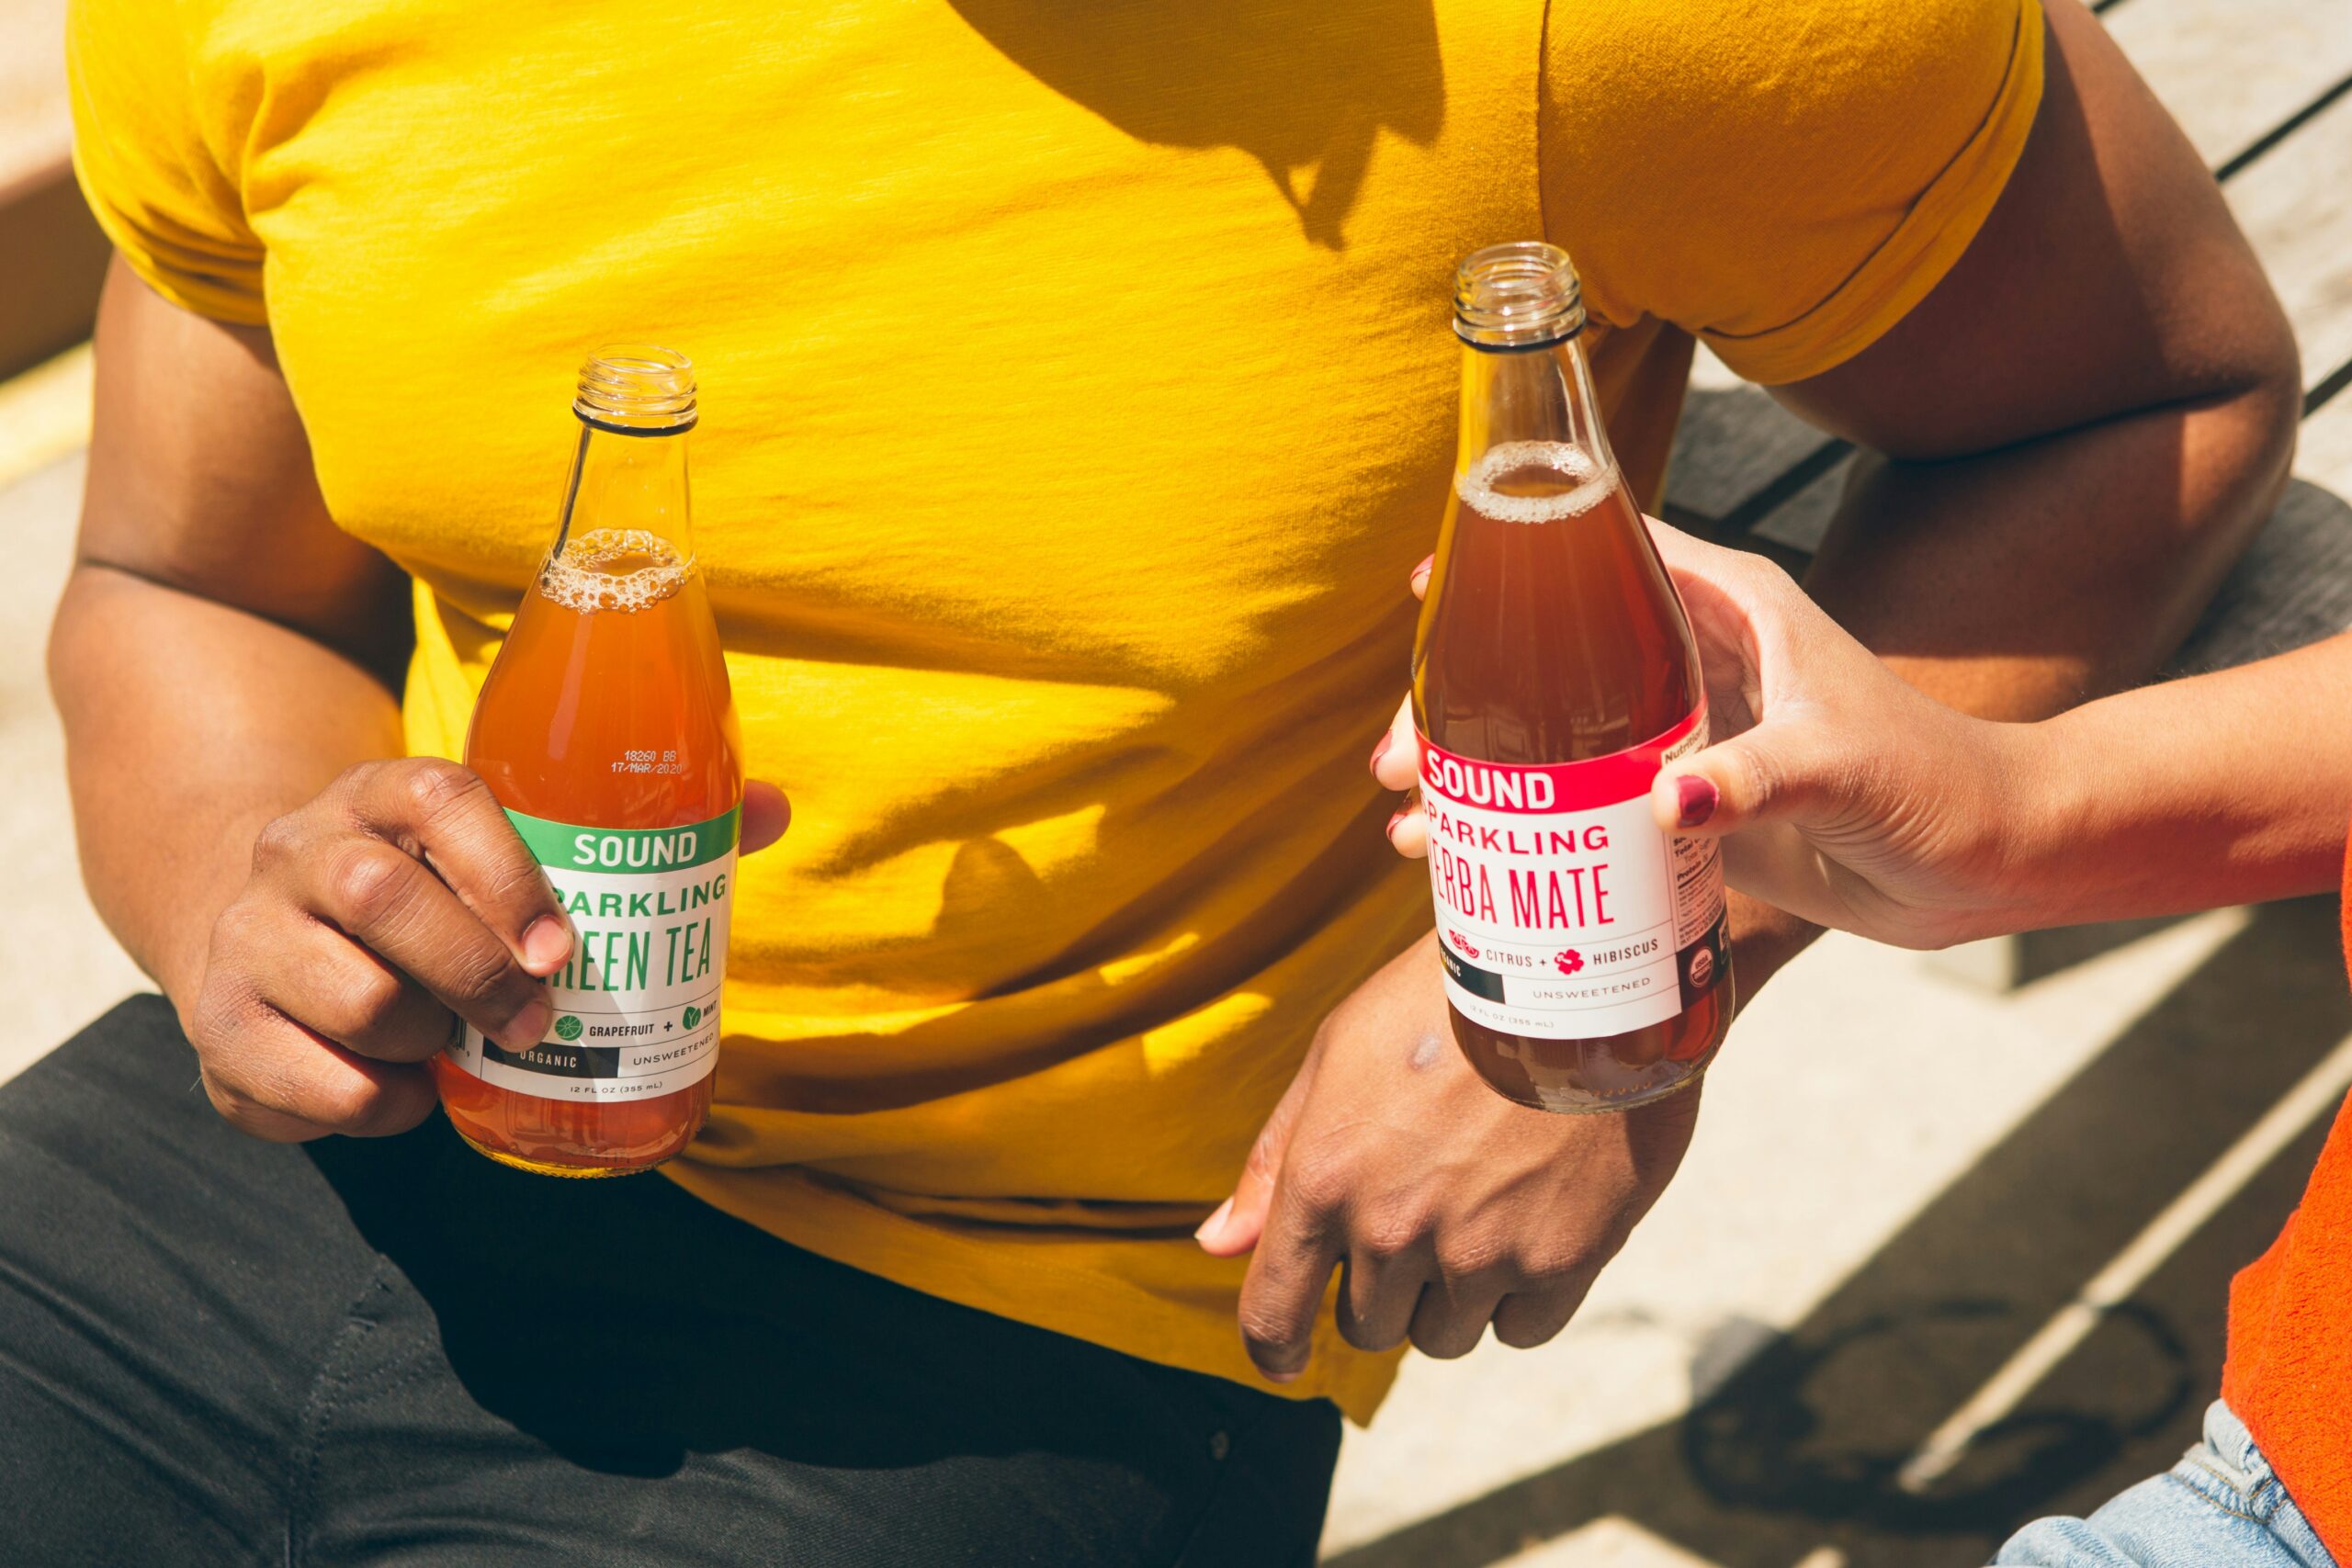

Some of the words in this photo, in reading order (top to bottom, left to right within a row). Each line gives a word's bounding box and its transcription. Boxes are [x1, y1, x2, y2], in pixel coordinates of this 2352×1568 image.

[611, 761, 683, 774] 17/MAR/2020
[624, 750, 656, 761] 18260
[662, 750, 677, 762] BB
[1427, 749, 1555, 809] SOUND
[572, 831, 697, 867] SOUND
[552, 874, 727, 918] ARKLING
[1509, 863, 1614, 930] MATE
[542, 931, 650, 991] EEN
[666, 917, 711, 987] TEA
[1486, 949, 1532, 967] CITRUS
[1593, 939, 1659, 965] HIBISCUS
[1532, 977, 1651, 999] UNSWEETENED
[589, 1023, 654, 1037] GRAPEFRUIT
[1493, 1013, 1505, 1021] OZ
[1509, 1016, 1531, 1026] (355
[520, 1051, 577, 1068] ORGANIC
[633, 1032, 714, 1066] UNSWEETENED
[620, 1085, 643, 1094] (355
[646, 1081, 663, 1090] mL)
